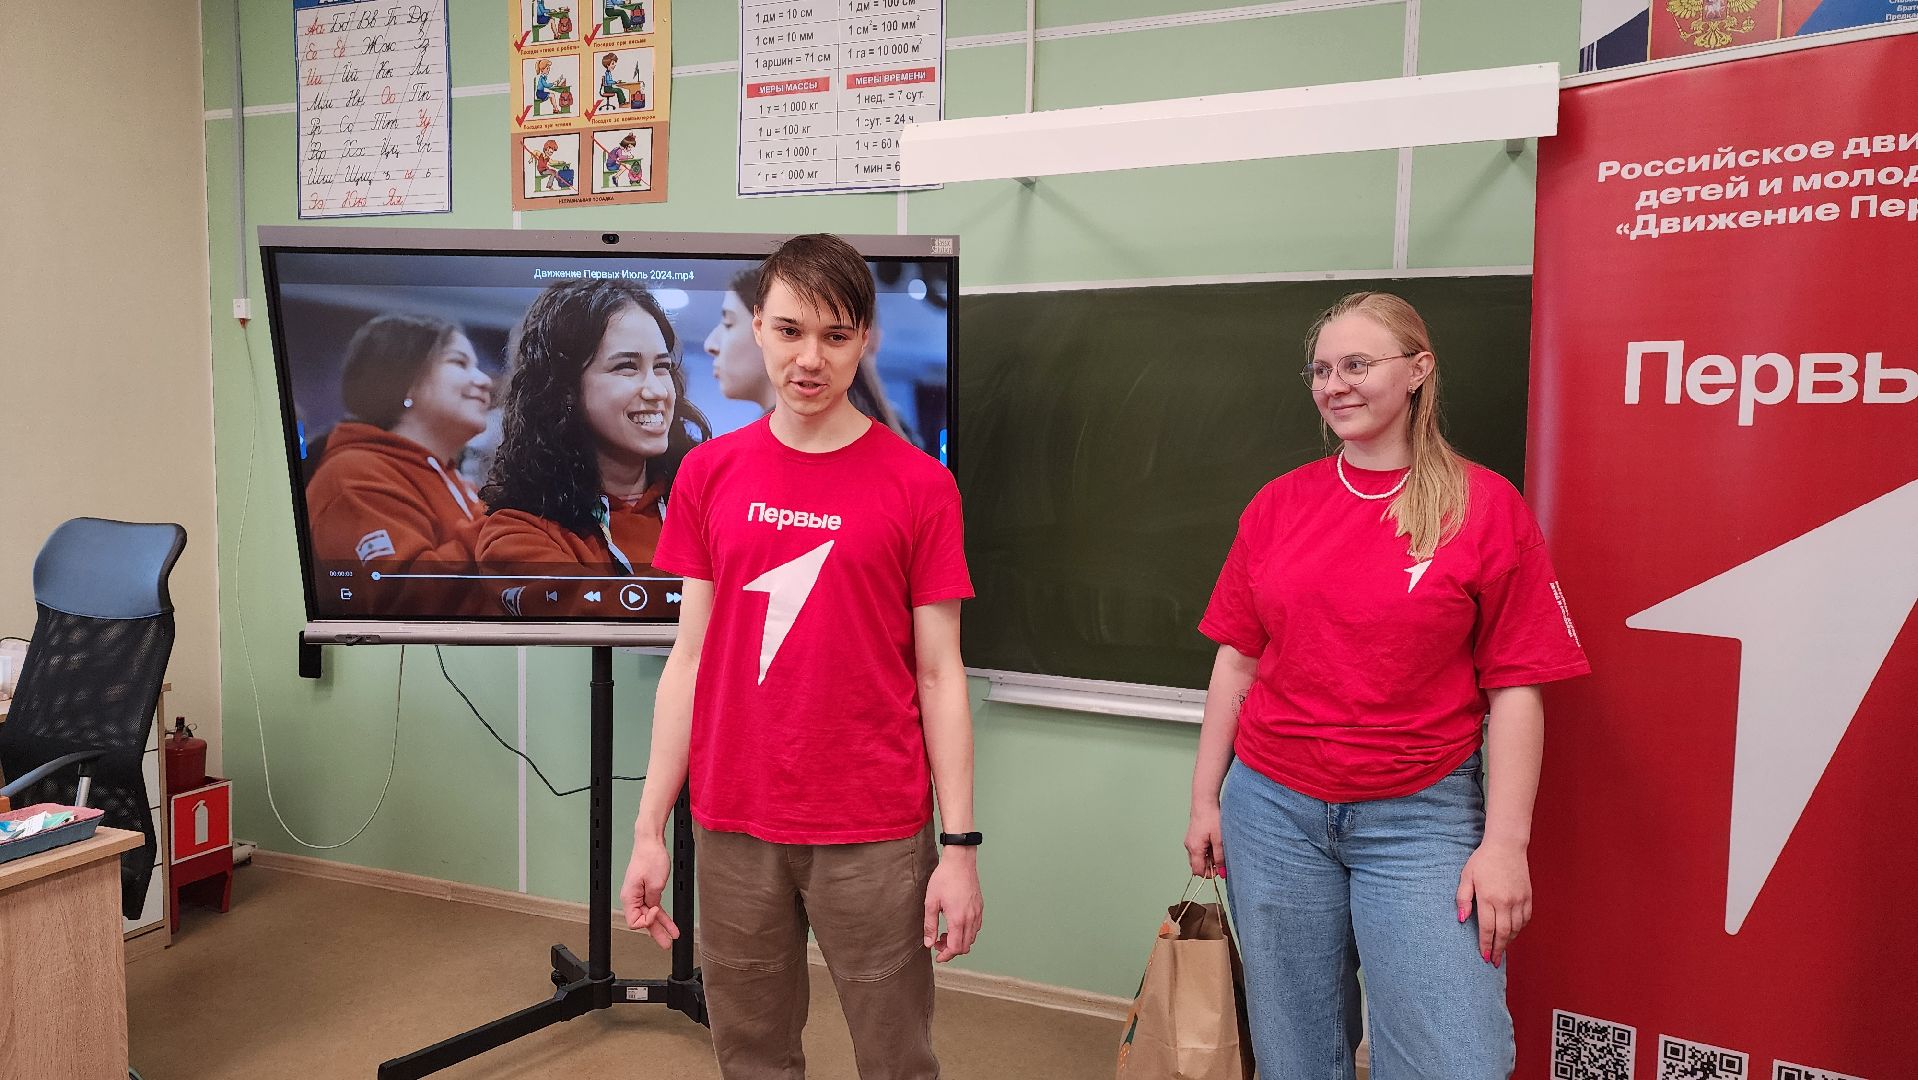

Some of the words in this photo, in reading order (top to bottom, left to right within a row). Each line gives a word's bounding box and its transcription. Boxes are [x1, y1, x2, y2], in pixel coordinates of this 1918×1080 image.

[763, 13, 776, 23] дм
[787, 8, 798, 20] 10
[800, 9, 813, 18] см
[882, 20, 898, 32] 100
[763, 36, 775, 46] см
[788, 32, 797, 43] 10
[800, 32, 814, 41] мм
[856, 50, 866, 59] га
[878, 45, 889, 56] 10
[892, 43, 909, 55] 000
[763, 57, 793, 70] аршин
[805, 52, 814, 63] 71
[817, 53, 831, 62] см
[855, 75, 882, 85] МЕРЫ
[884, 71, 926, 83] ВРЕМЕНИ
[759, 85, 784, 94] МЕРЫ
[785, 81, 818, 91] МАССЫ
[898, 90, 903, 100] 7
[790, 101, 806, 112] 000
[809, 102, 819, 111] кг
[894, 113, 906, 125] 24
[783, 124, 799, 135] 100
[802, 125, 812, 134] кг
[864, 141, 869, 151] ч
[881, 138, 892, 149] 60
[765, 151, 774, 159] кг
[793, 146, 810, 157] 000
[812, 148, 817, 156] г
[864, 164, 883, 174] мин
[895, 161, 901, 172] 6
[1598, 139, 1835, 183] Российское
[788, 169, 805, 180] 000
[807, 171, 818, 179] мг
[1635, 175, 1750, 211] детей
[1759, 177, 1783, 197] и
[1615, 201, 1841, 240] «Движение
[534, 268, 582, 280] Движение
[583, 269, 620, 282] Первых
[621, 269, 648, 280] Июль
[650, 270, 694, 282] 2024.mp4
[747, 502, 842, 531] Первые
